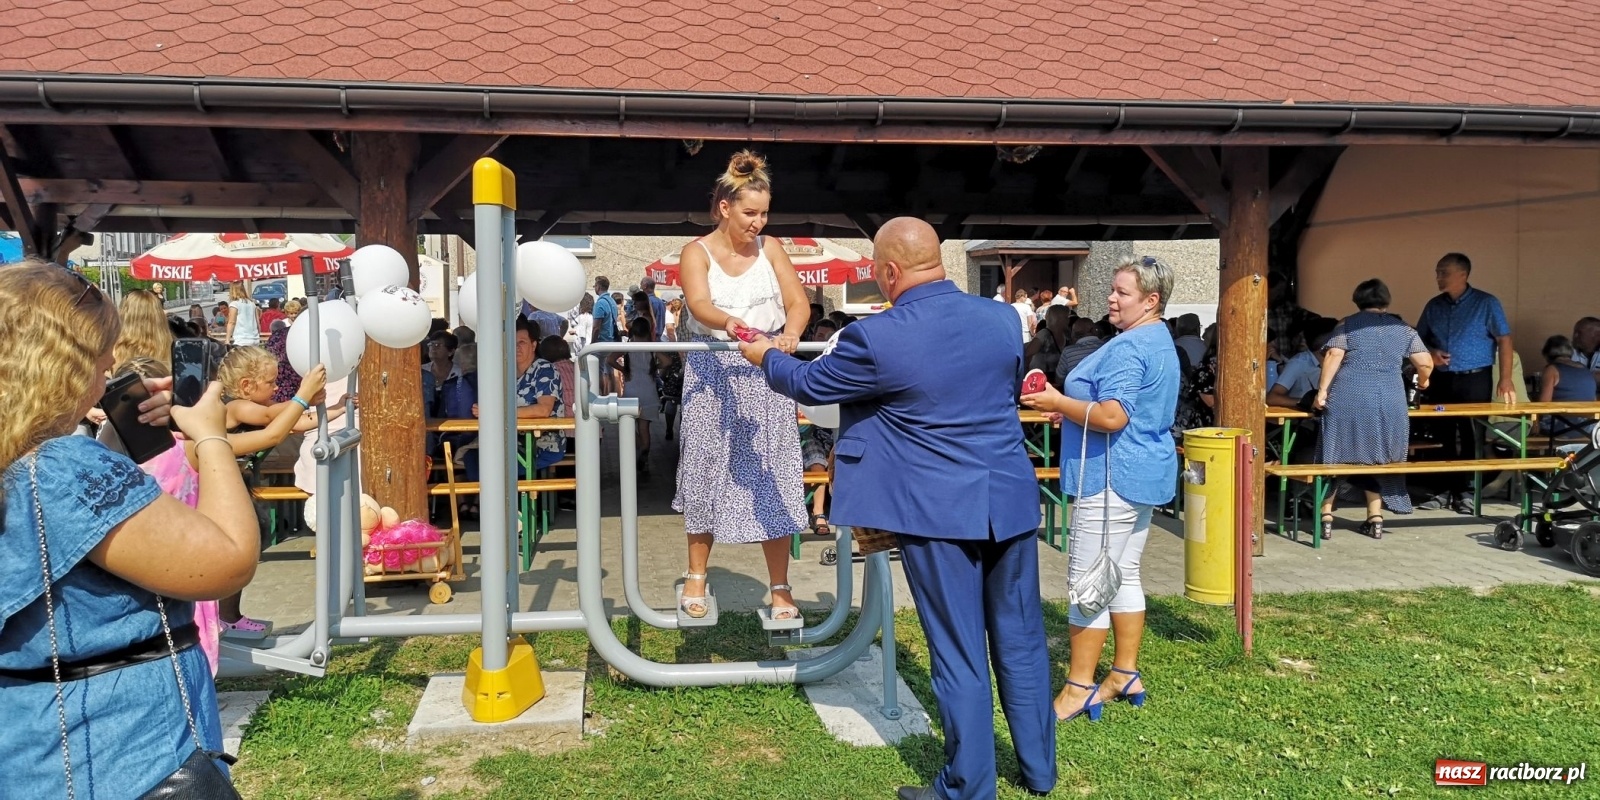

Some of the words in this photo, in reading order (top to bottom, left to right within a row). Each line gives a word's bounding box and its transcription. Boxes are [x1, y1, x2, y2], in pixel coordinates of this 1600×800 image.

[150, 263, 193, 280] TYSKIE
[234, 260, 289, 279] TYSKIE
[323, 256, 346, 271] TYS
[650, 268, 667, 284] TYSKIE
[796, 267, 829, 284] SKIE
[855, 264, 872, 281] TYSKIE
